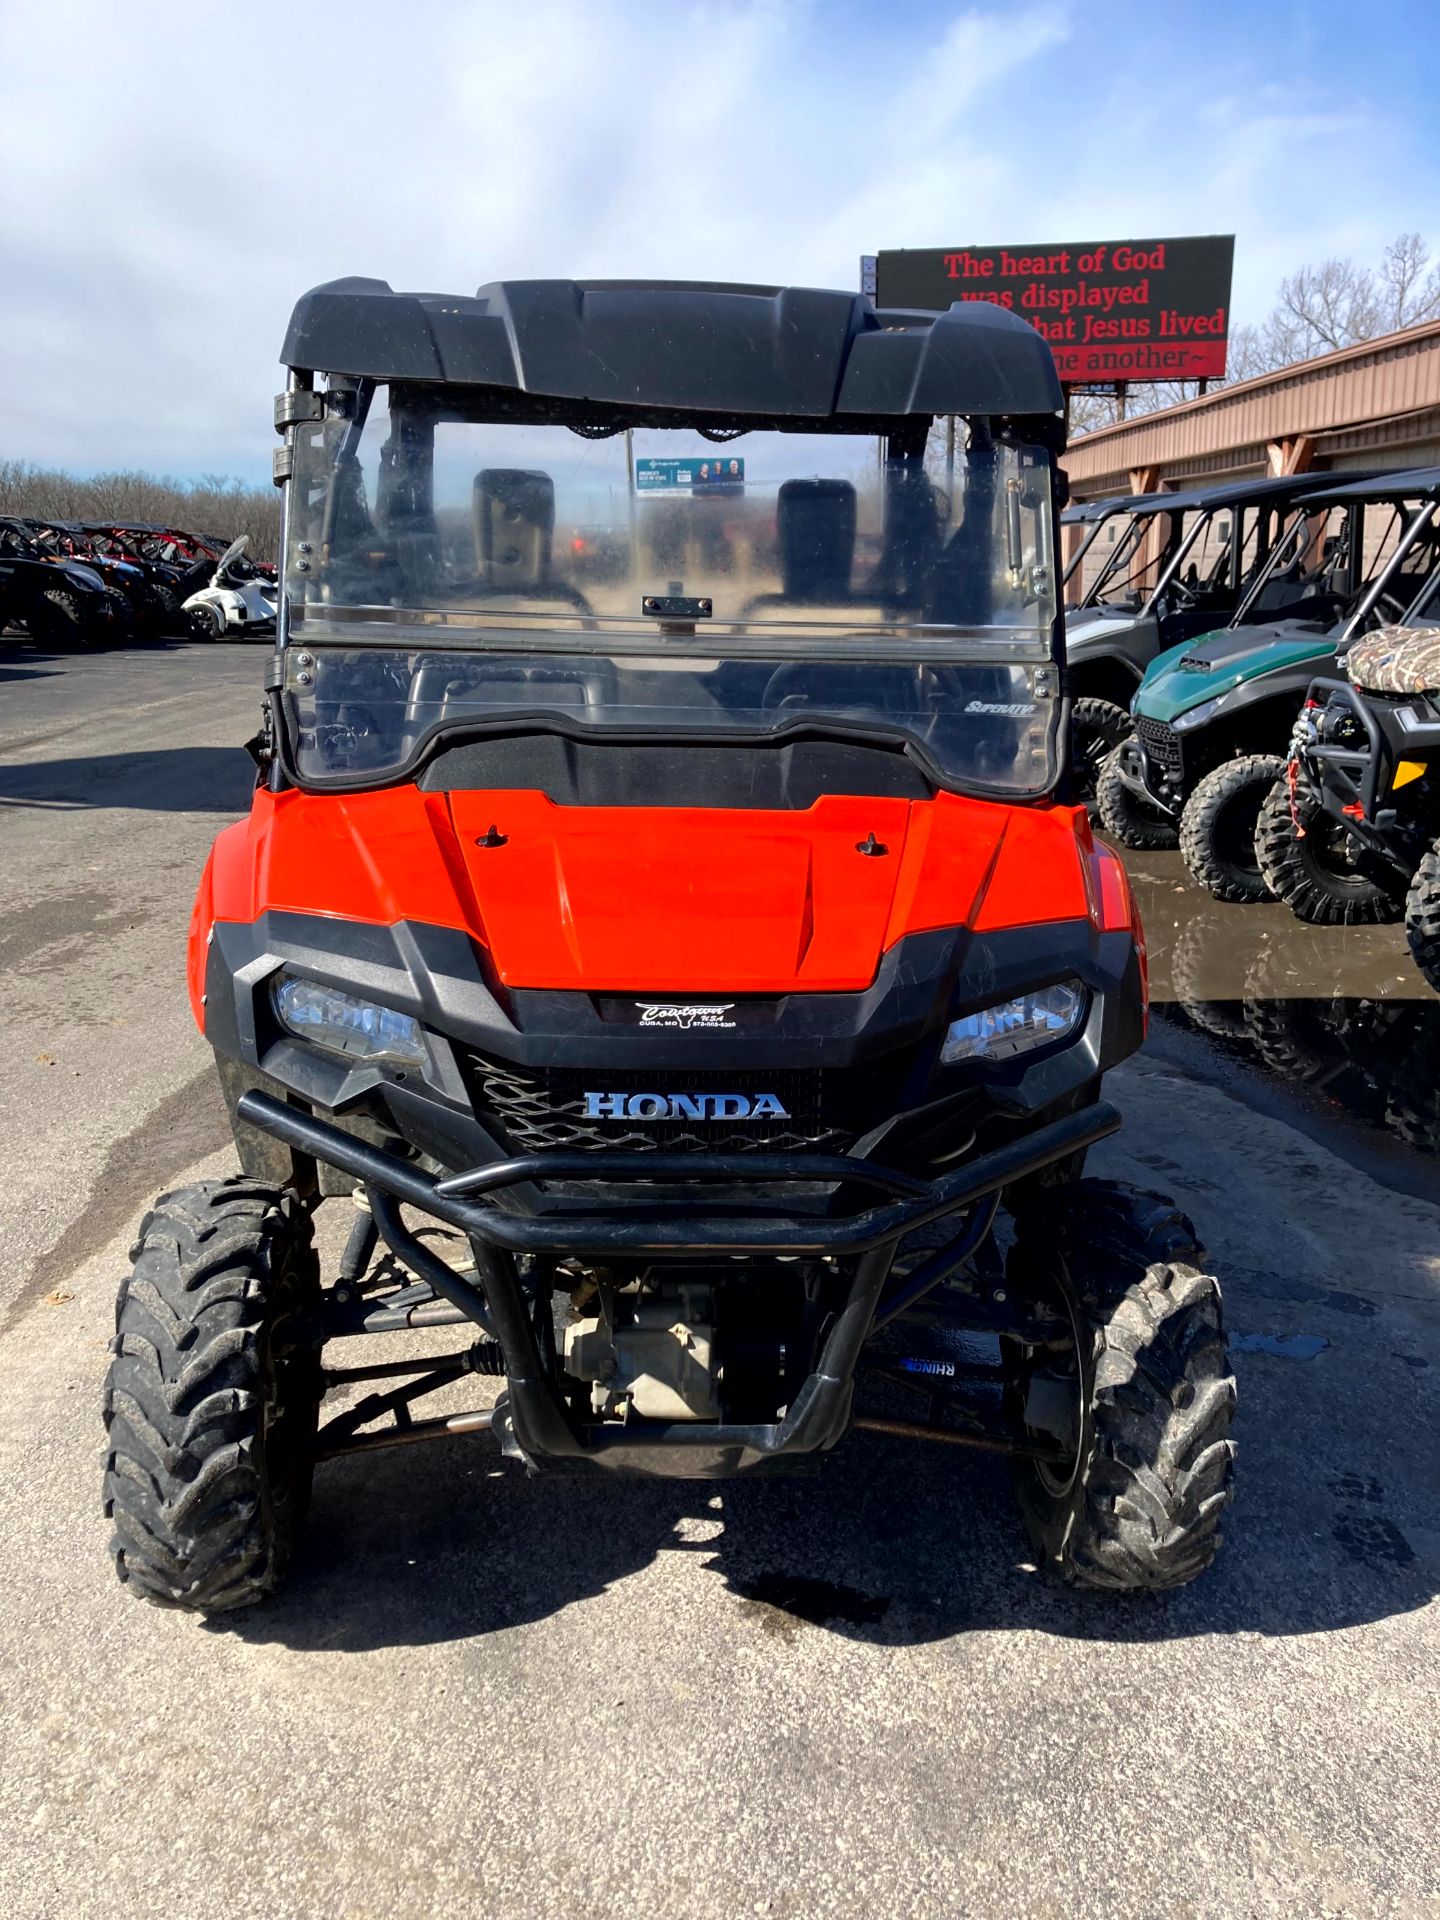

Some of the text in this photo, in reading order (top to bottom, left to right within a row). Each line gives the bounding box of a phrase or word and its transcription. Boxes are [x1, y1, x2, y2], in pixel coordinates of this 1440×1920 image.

[944, 244, 1166, 278] The heart of God
[961, 279, 1150, 314] was displayed
[1025, 308, 1225, 343] hat Jesus lived
[1054, 354, 1078, 371] ne
[641, 1007, 725, 1021] Cowtown
[584, 1092, 791, 1120] HONDA
[914, 1362, 955, 1376] RHINO
